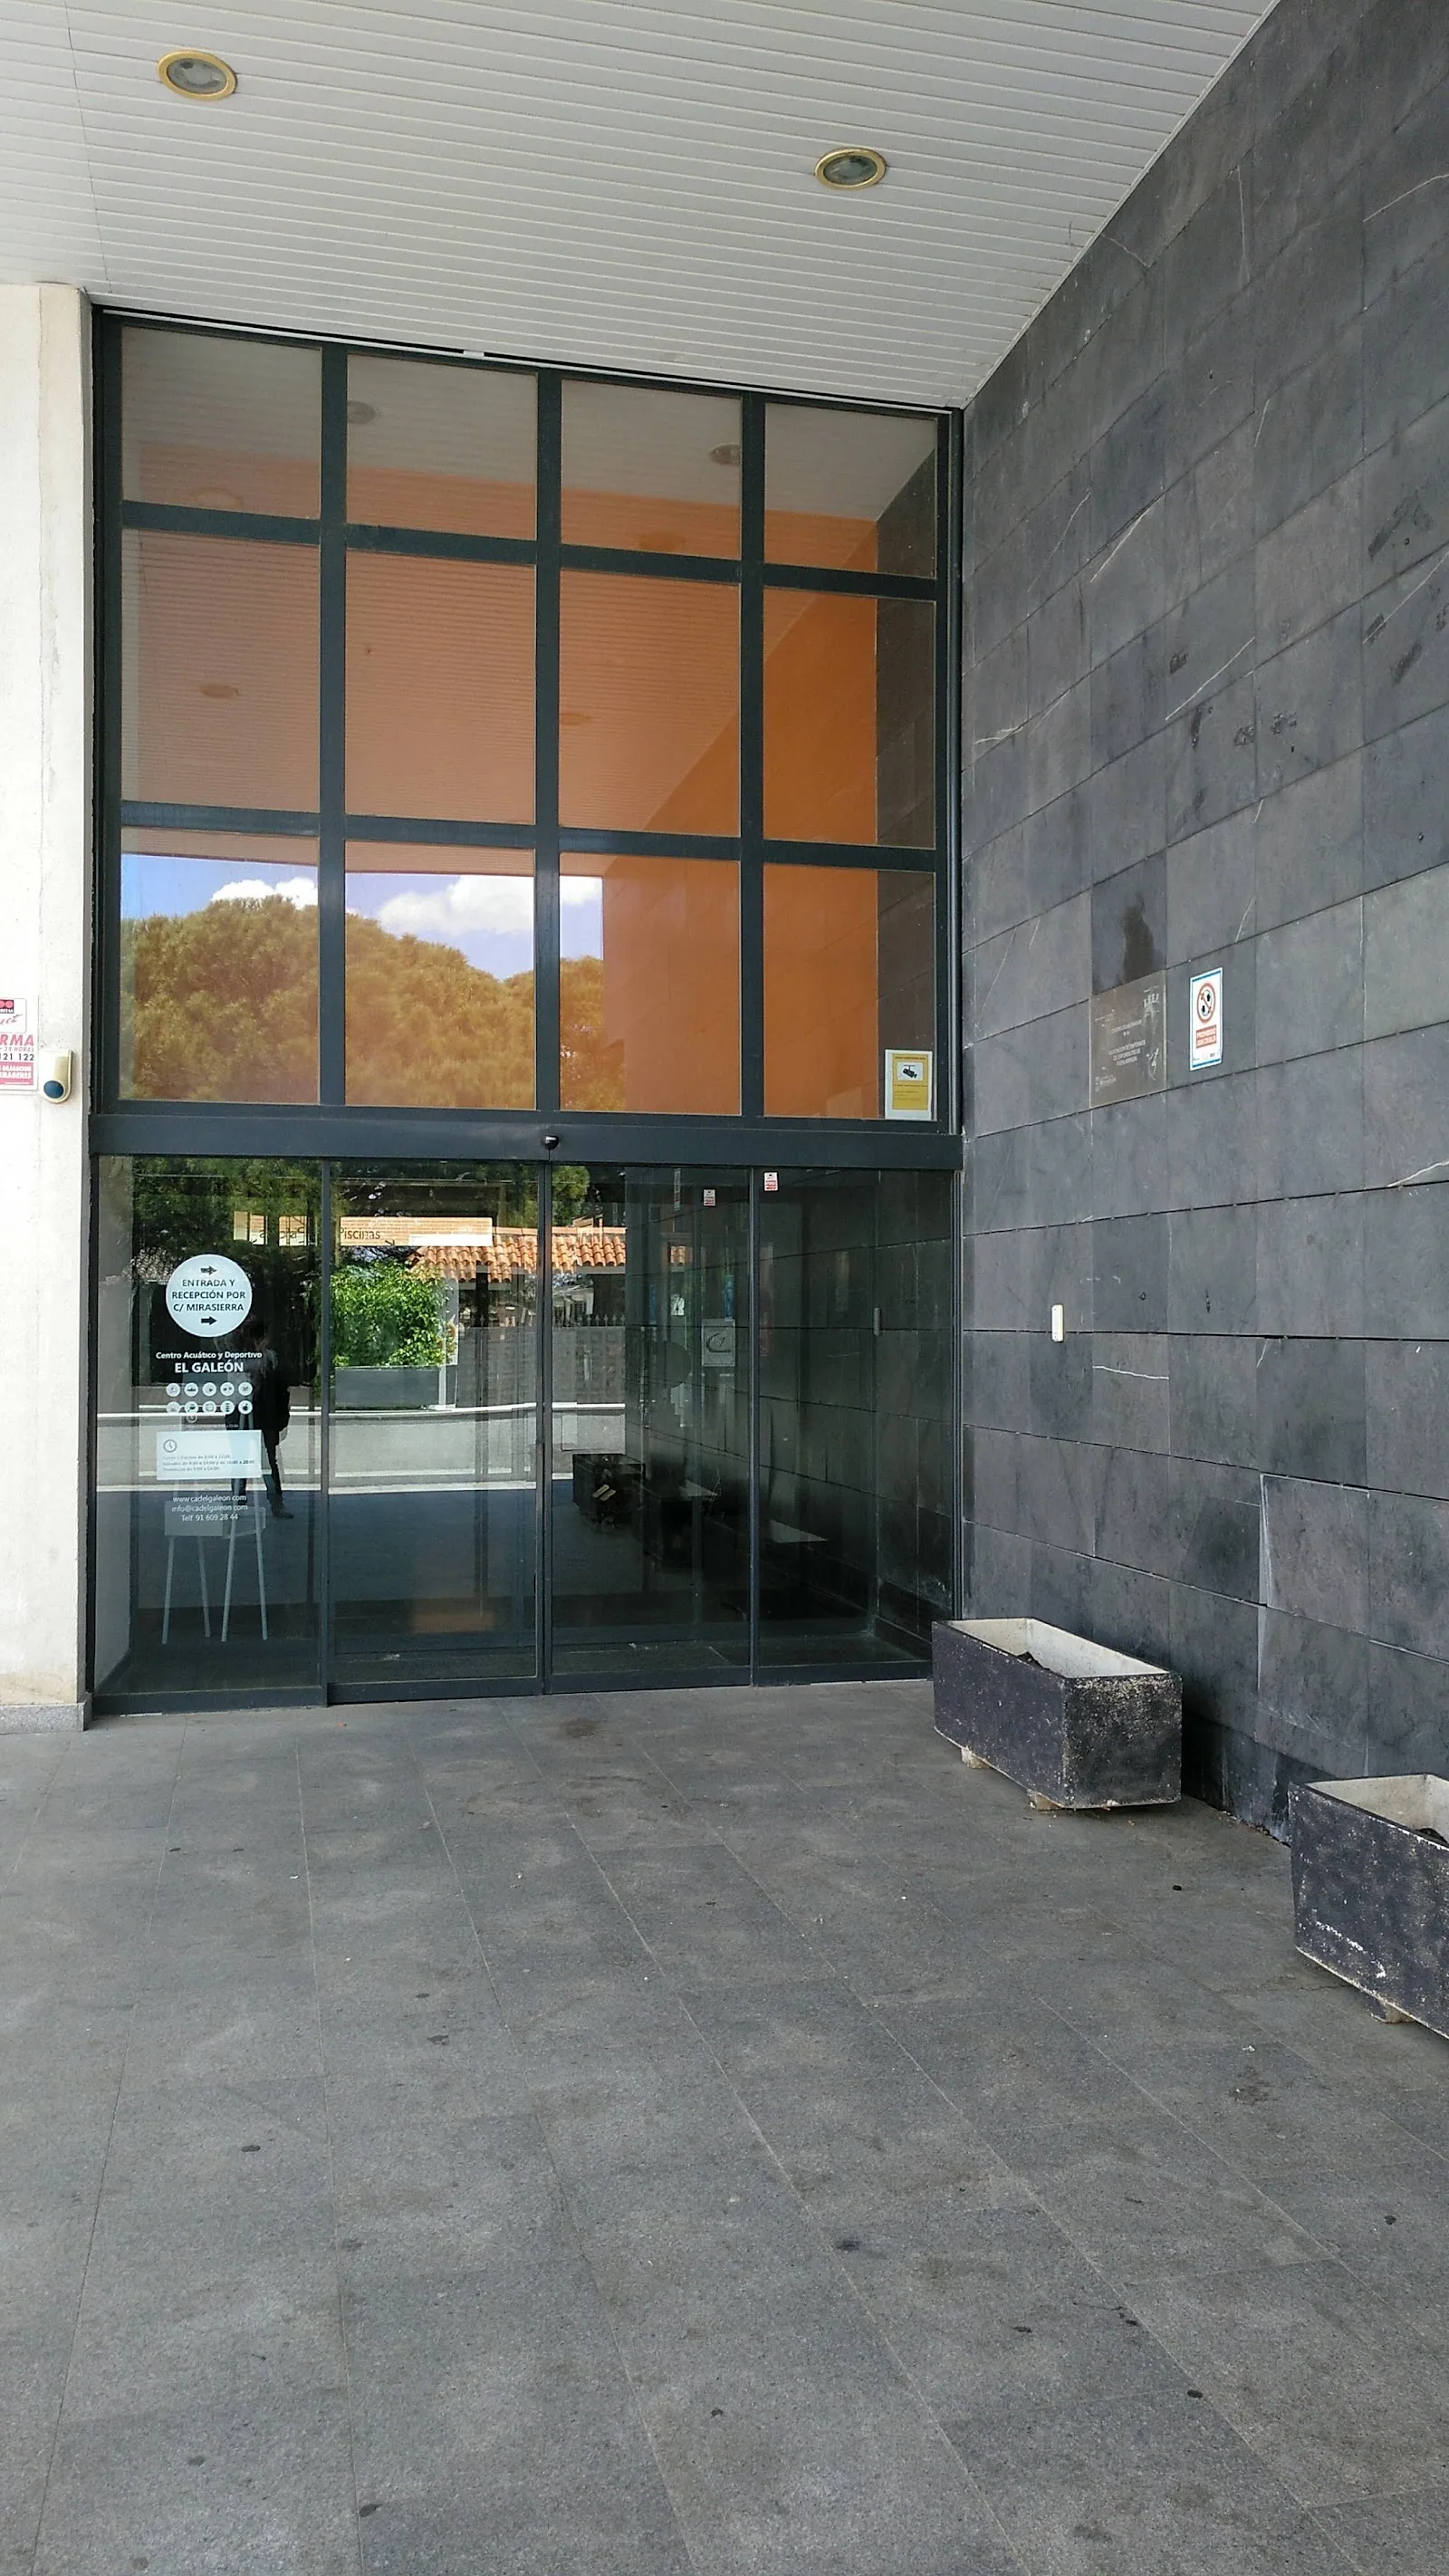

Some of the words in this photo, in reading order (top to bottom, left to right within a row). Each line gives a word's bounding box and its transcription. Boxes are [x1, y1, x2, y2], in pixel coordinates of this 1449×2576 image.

[18, 1053, 34, 1062] 122
[182, 1279, 226, 1287] ENTRADA
[229, 1279, 235, 1287] Y
[172, 1290, 224, 1299] RECEPCIÓN
[226, 1291, 245, 1299] POR
[173, 1303, 184, 1312] C/
[187, 1303, 245, 1312] MIRASIERRA
[218, 1352, 223, 1360] y
[225, 1351, 263, 1360] Deportivo
[175, 1362, 189, 1373] EL
[191, 1360, 245, 1373] GALEÓN
